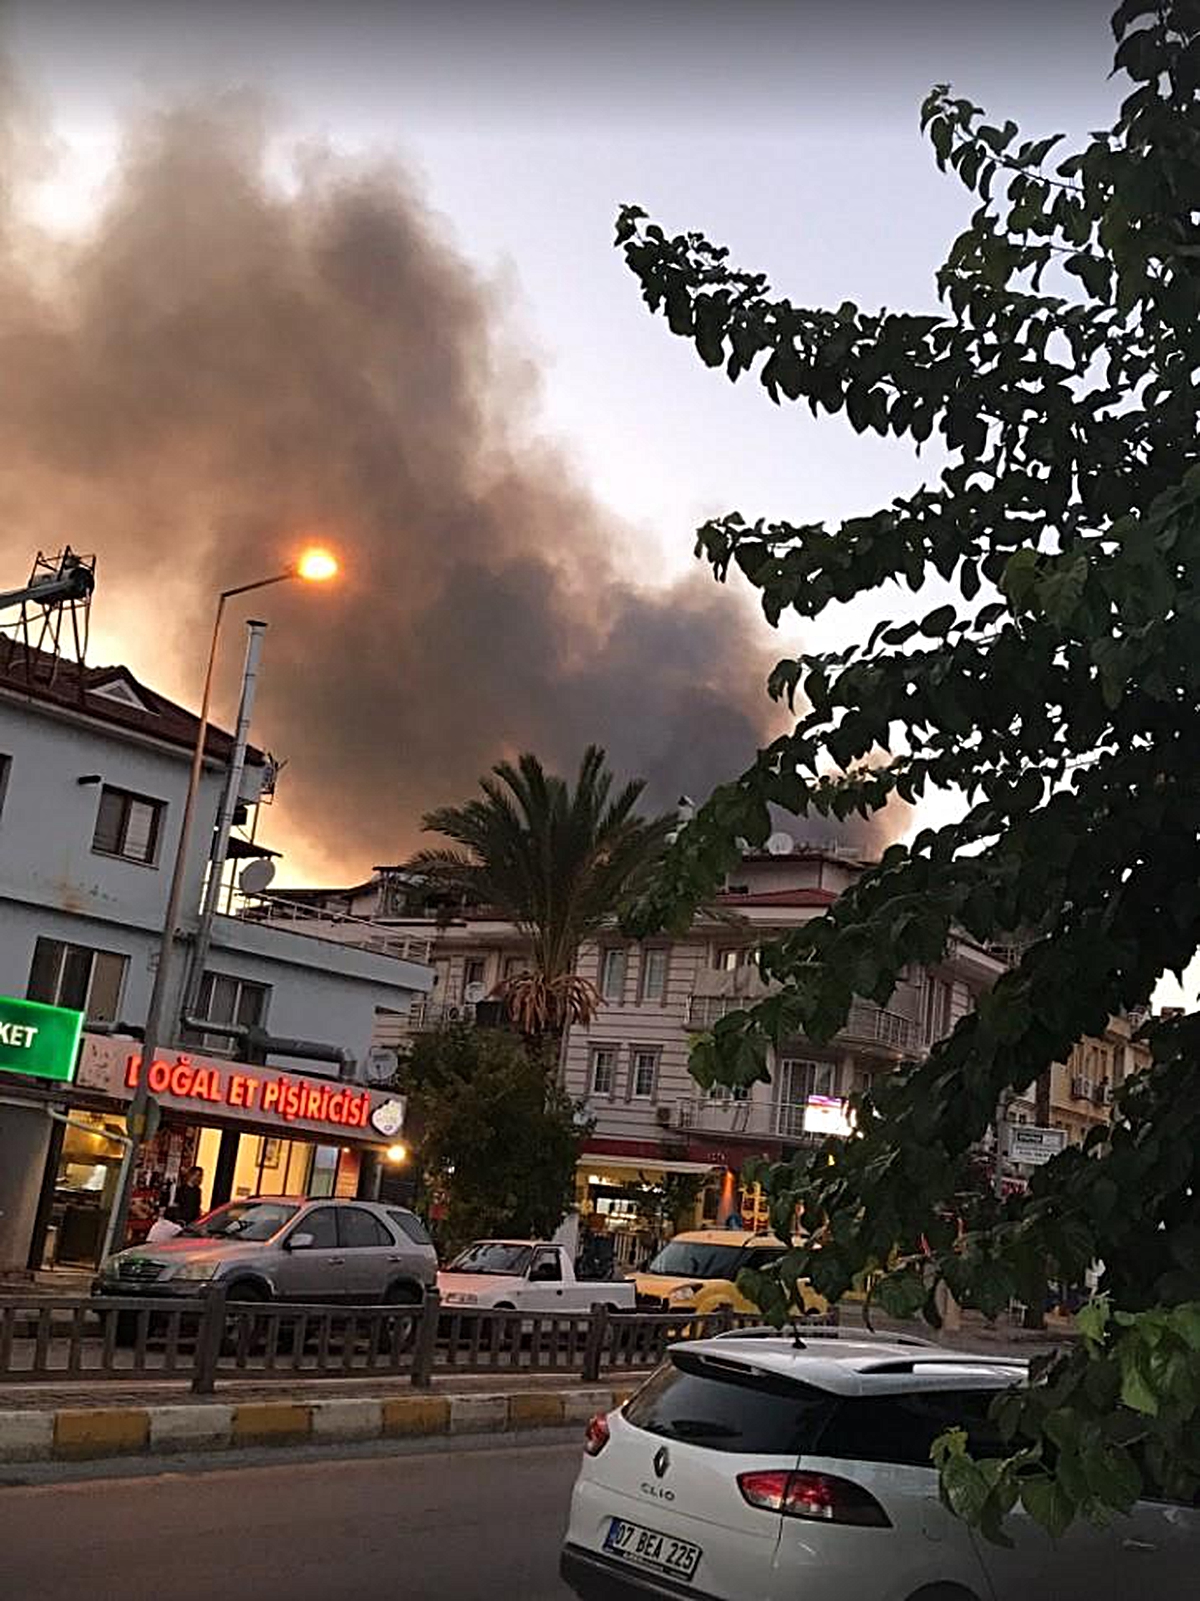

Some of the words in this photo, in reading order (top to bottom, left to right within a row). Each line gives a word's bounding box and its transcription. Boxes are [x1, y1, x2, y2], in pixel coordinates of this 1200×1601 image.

[226, 1074, 259, 1108] ET
[261, 1076, 371, 1127] PİŞİRİCİSİ
[641, 1482, 675, 1501] CLIO
[615, 1524, 635, 1547] 07
[636, 1531, 664, 1560] BEA
[665, 1542, 697, 1570] 225
